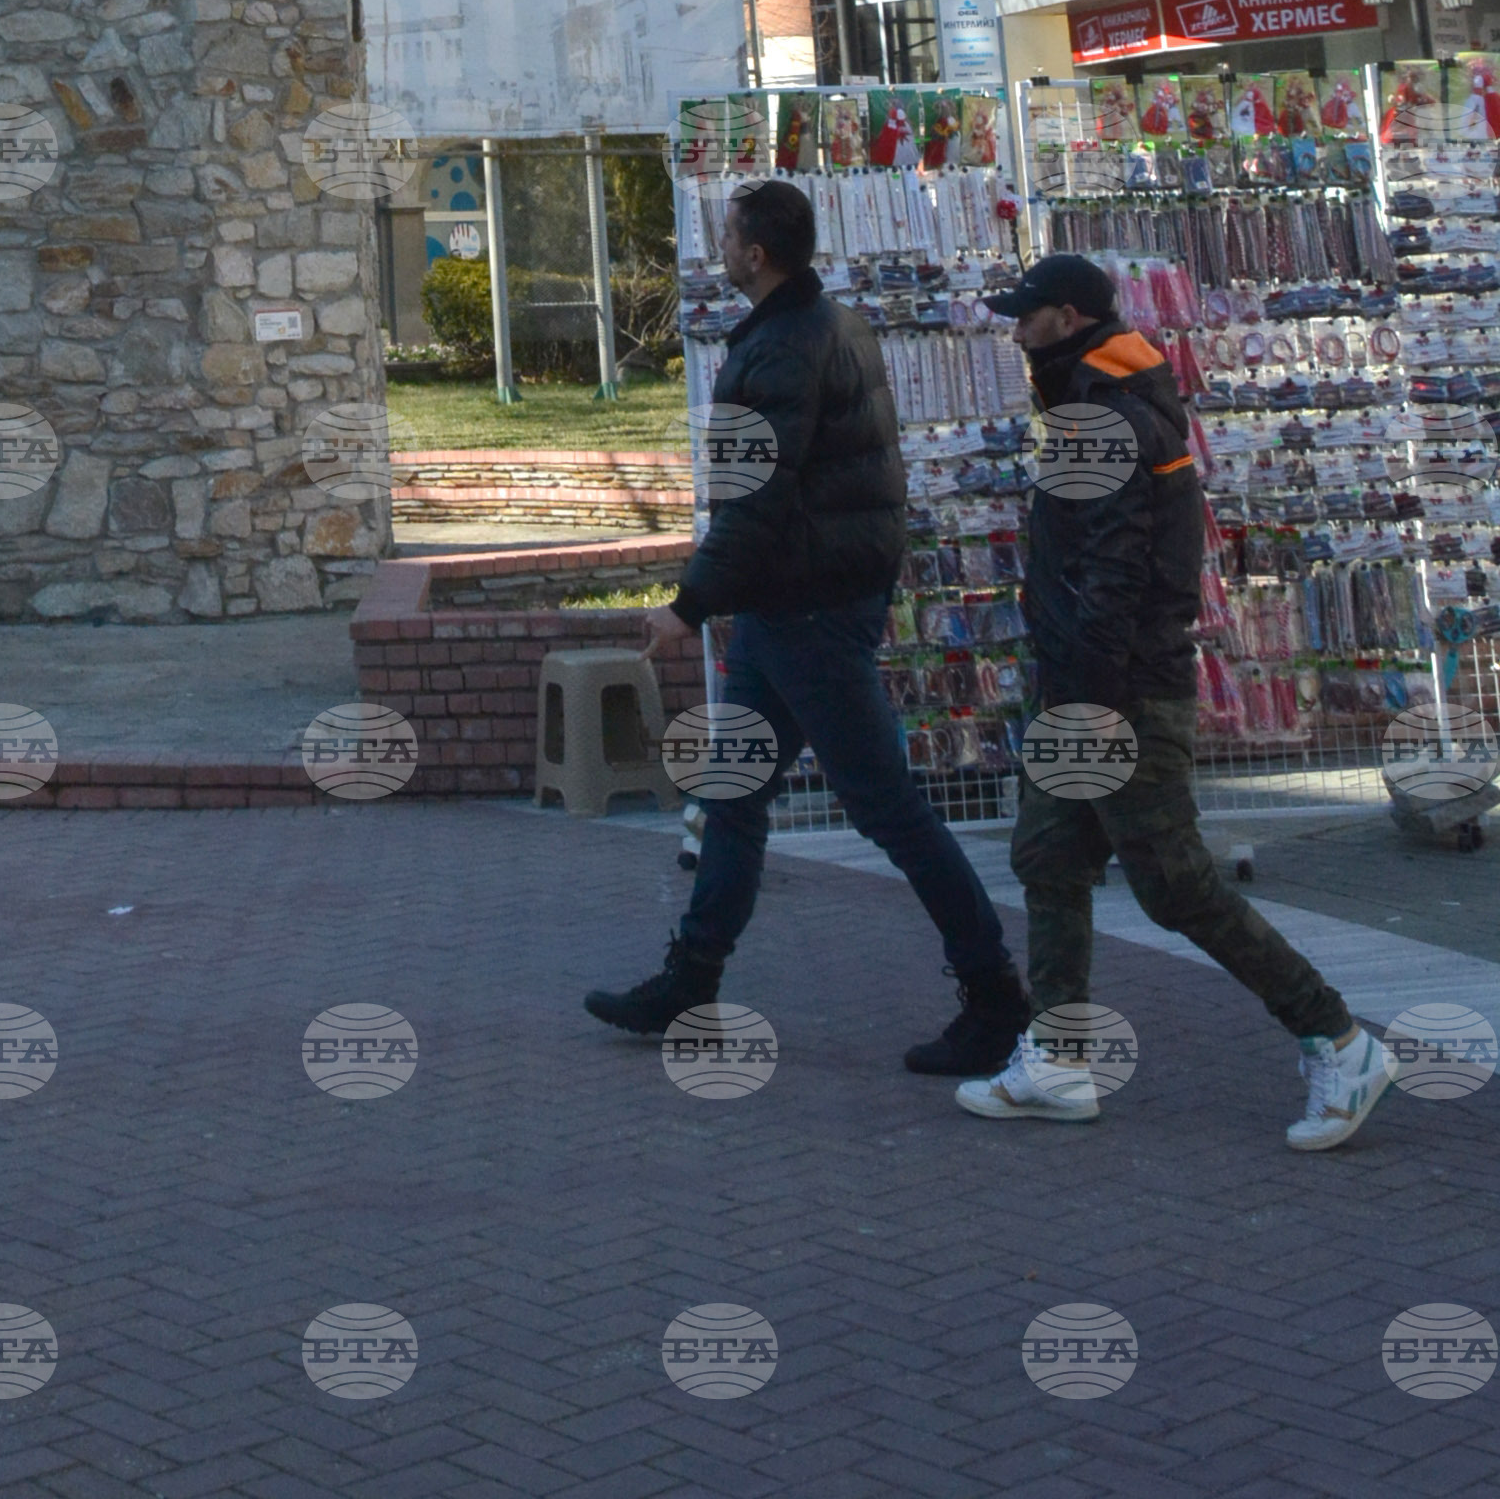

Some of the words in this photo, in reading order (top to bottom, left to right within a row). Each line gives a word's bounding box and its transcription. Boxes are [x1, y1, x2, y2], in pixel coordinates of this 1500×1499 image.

[943, 17, 995, 29] ИНТЕРЛИЙЗ
[1250, 2, 1347, 34] ХЕРМЕС
[1108, 25, 1149, 52] ХЕРМЕС
